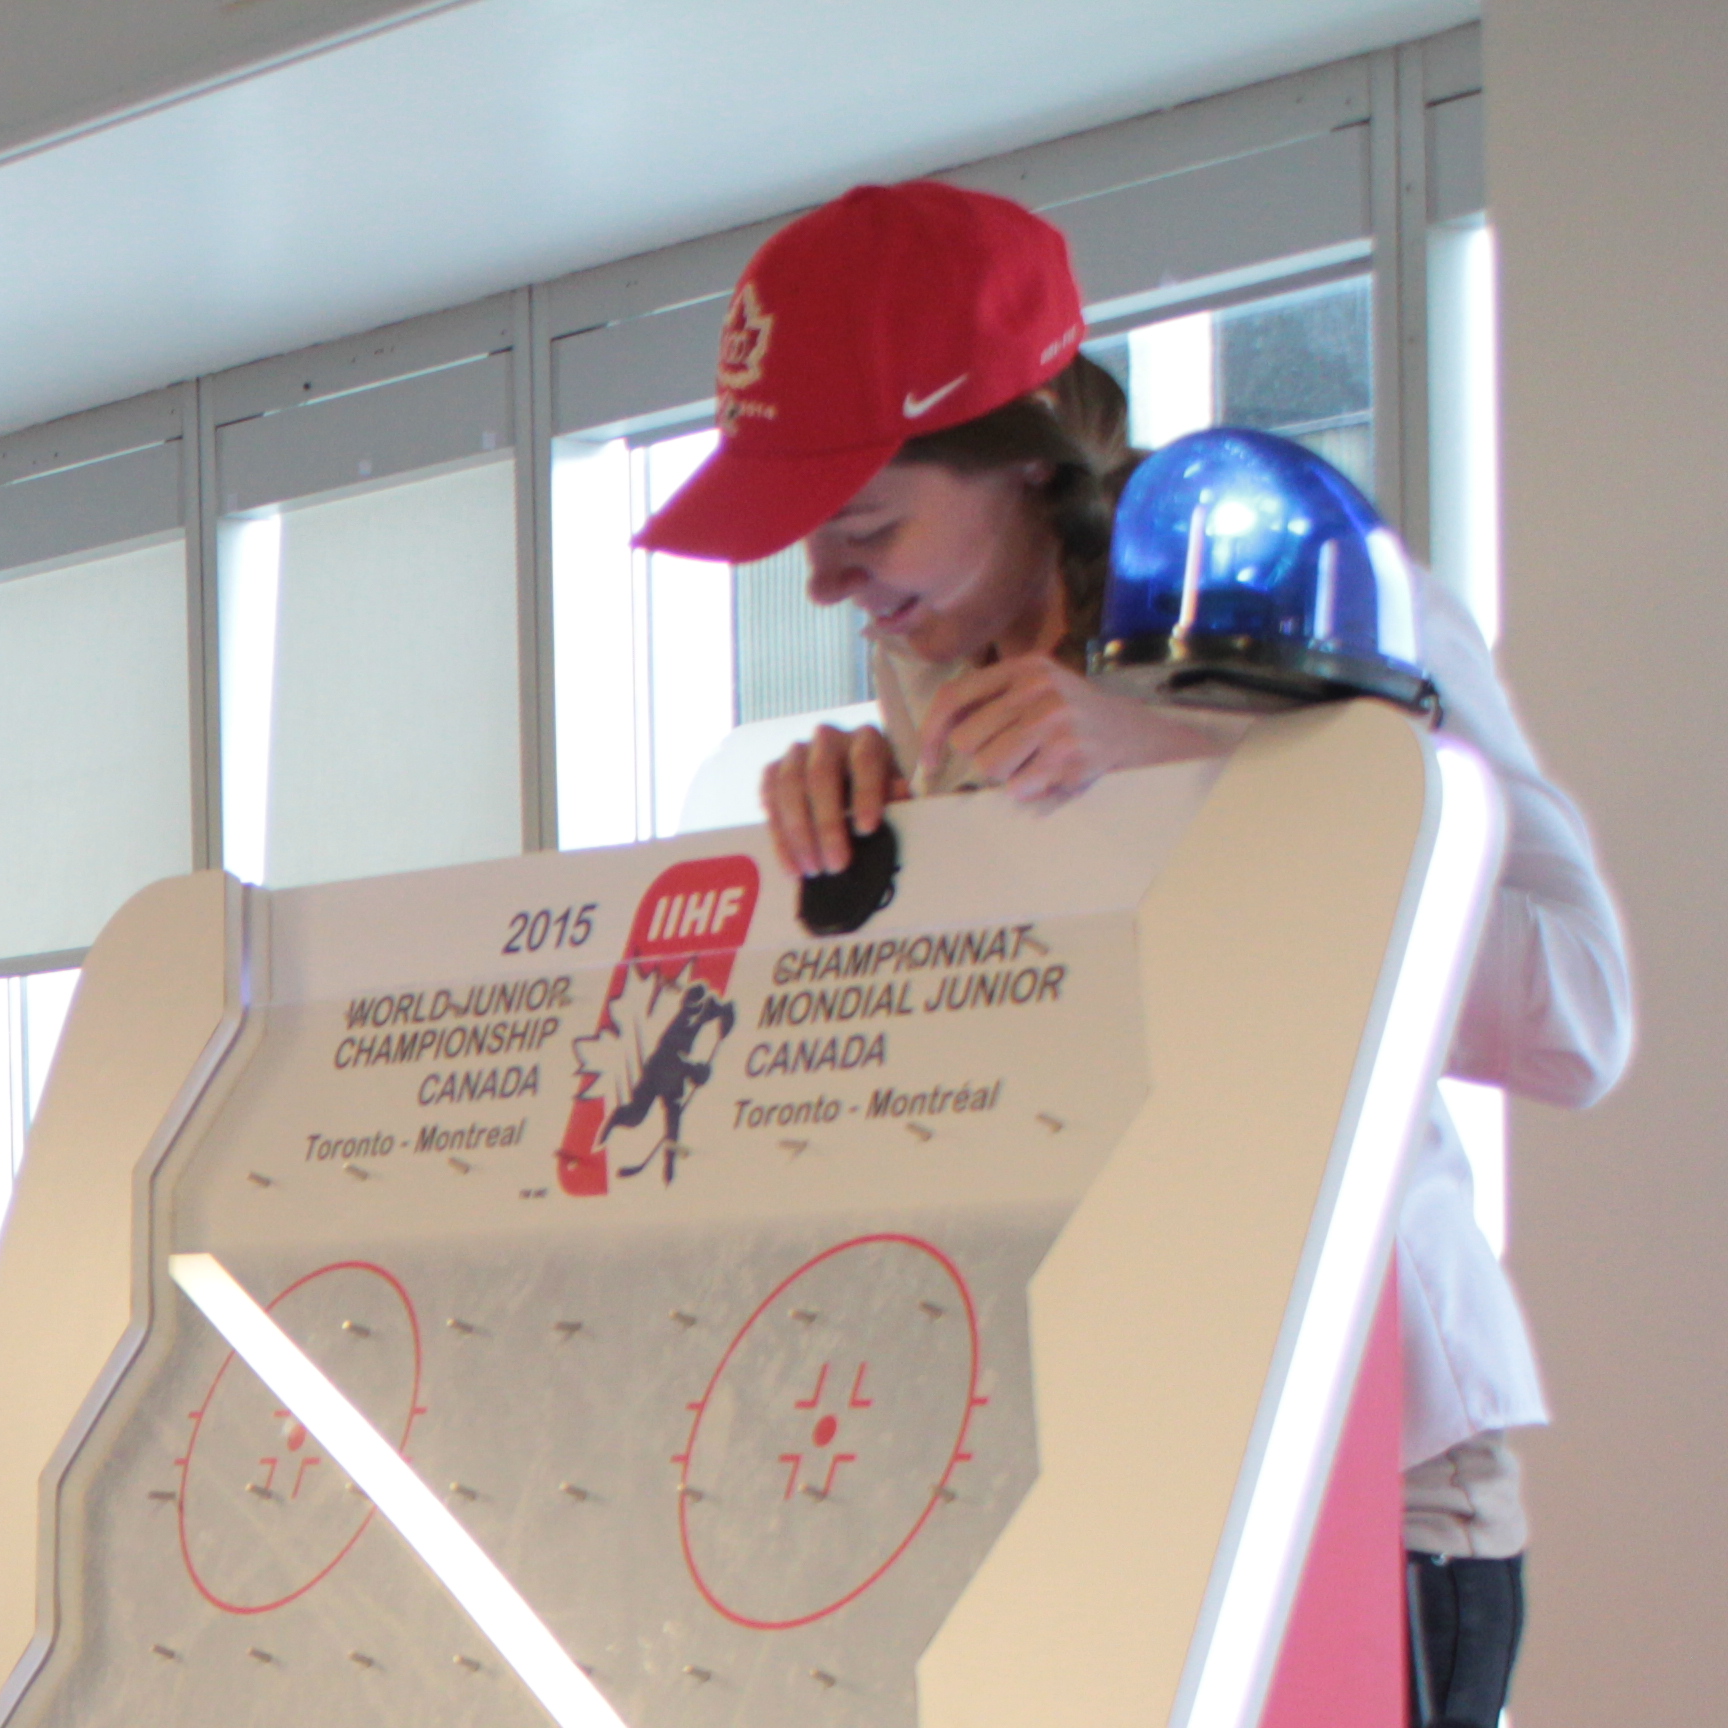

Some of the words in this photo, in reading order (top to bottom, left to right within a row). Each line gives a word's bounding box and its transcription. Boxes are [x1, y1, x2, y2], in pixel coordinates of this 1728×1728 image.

[501, 902, 598, 956] 2015
[647, 887, 745, 942] IIHF
[772, 923, 1034, 987] CHAMPIONNAT
[345, 989, 452, 1030] WORLD
[454, 975, 572, 1018] JUNIOR
[757, 980, 913, 1029] MONDIAL
[923, 964, 1067, 1013] JUNIOR
[333, 1016, 560, 1070] CHAMPIONSHIP
[745, 1032, 888, 1079] CANADA
[417, 1063, 541, 1106] CANADA
[732, 1095, 840, 1131] Toronto
[865, 1079, 1003, 1121] Montréal
[305, 1128, 395, 1161] Toronto
[414, 1117, 527, 1155] Montreal
